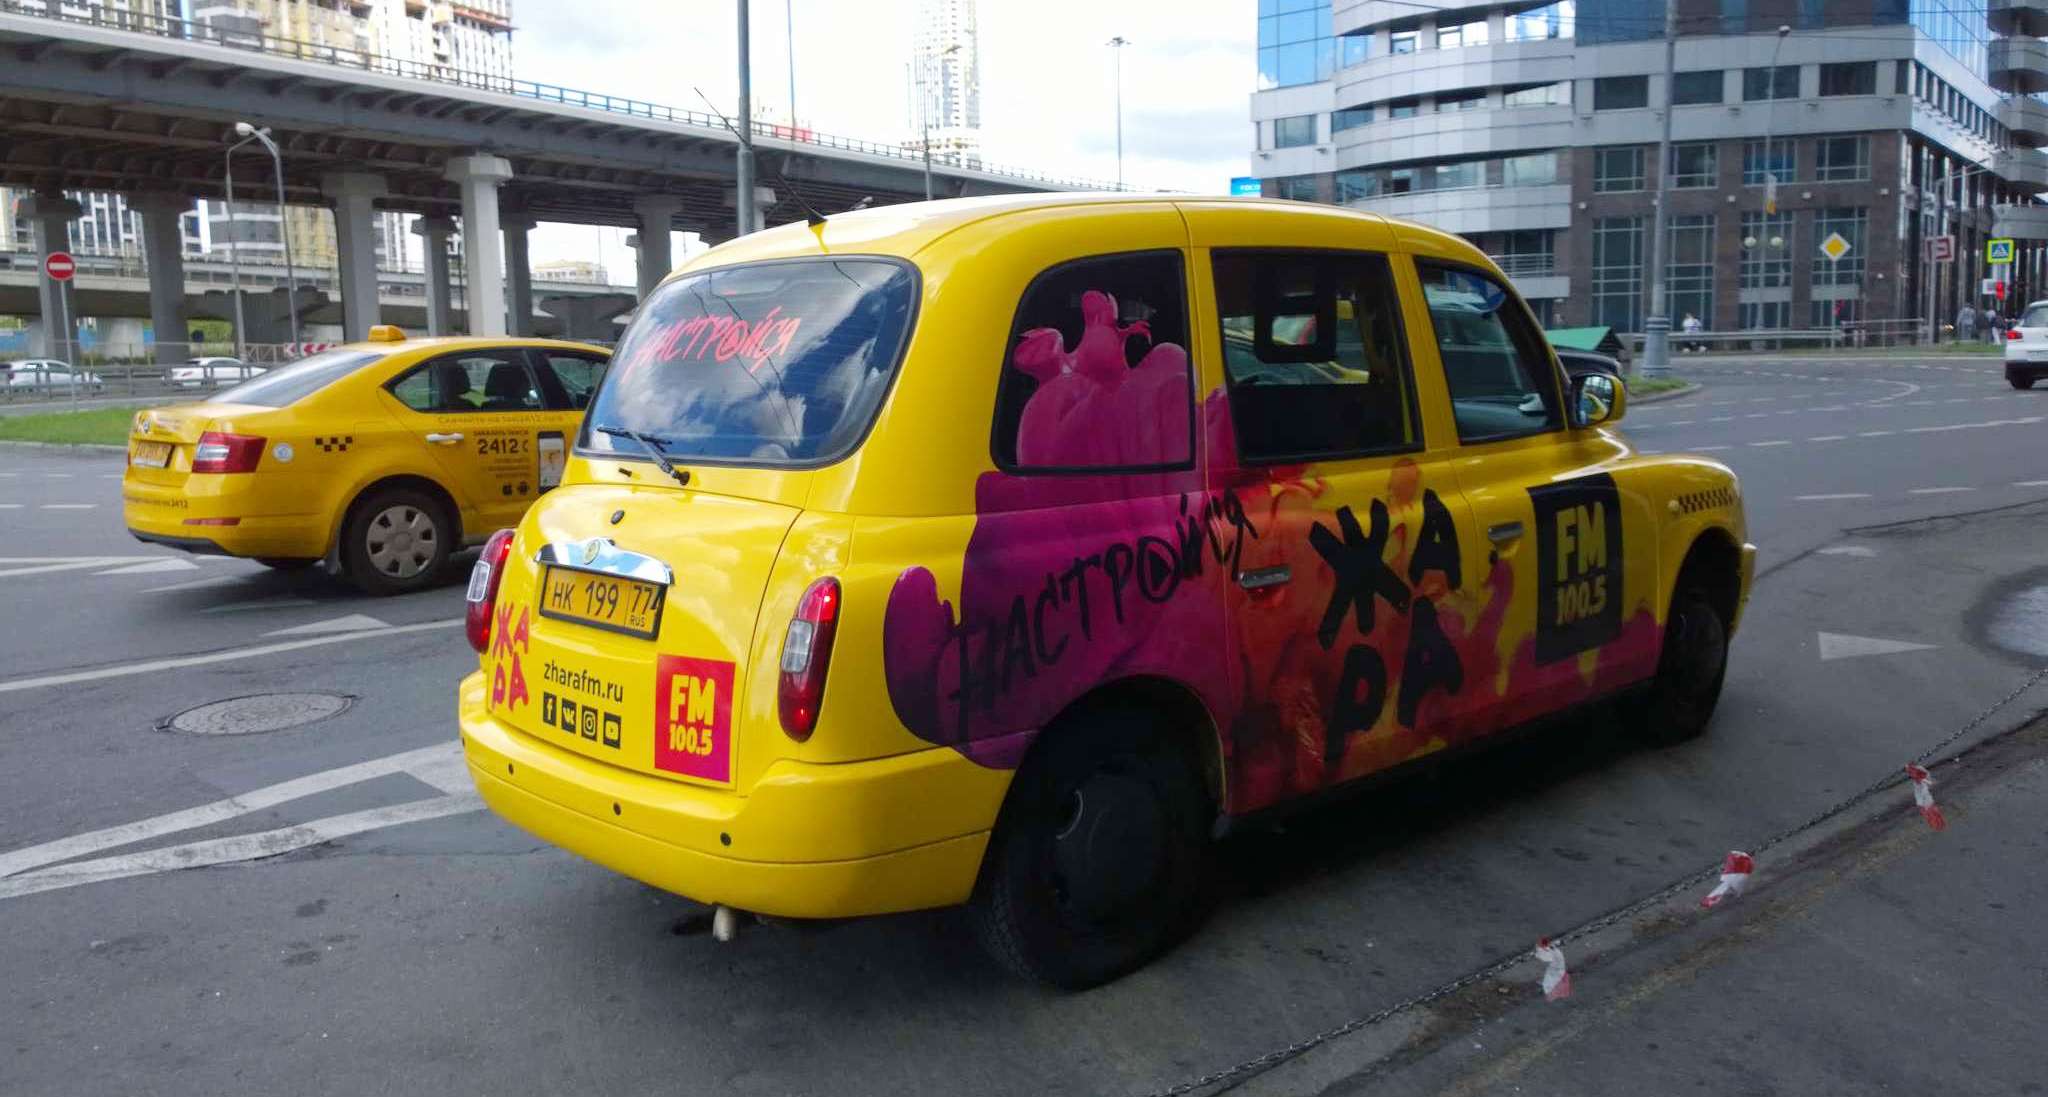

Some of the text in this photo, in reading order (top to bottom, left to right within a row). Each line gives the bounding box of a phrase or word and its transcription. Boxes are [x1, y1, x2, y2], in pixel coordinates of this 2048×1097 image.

[478, 438, 519, 455] 2412
[1556, 501, 1607, 582] FM
[585, 580, 619, 619] 199
[1556, 574, 1607, 626] 100.5
[630, 615, 645, 628] RUS
[544, 660, 624, 703] zharafm.ru
[670, 673, 716, 726] FM
[669, 722, 713, 756] 100.5
